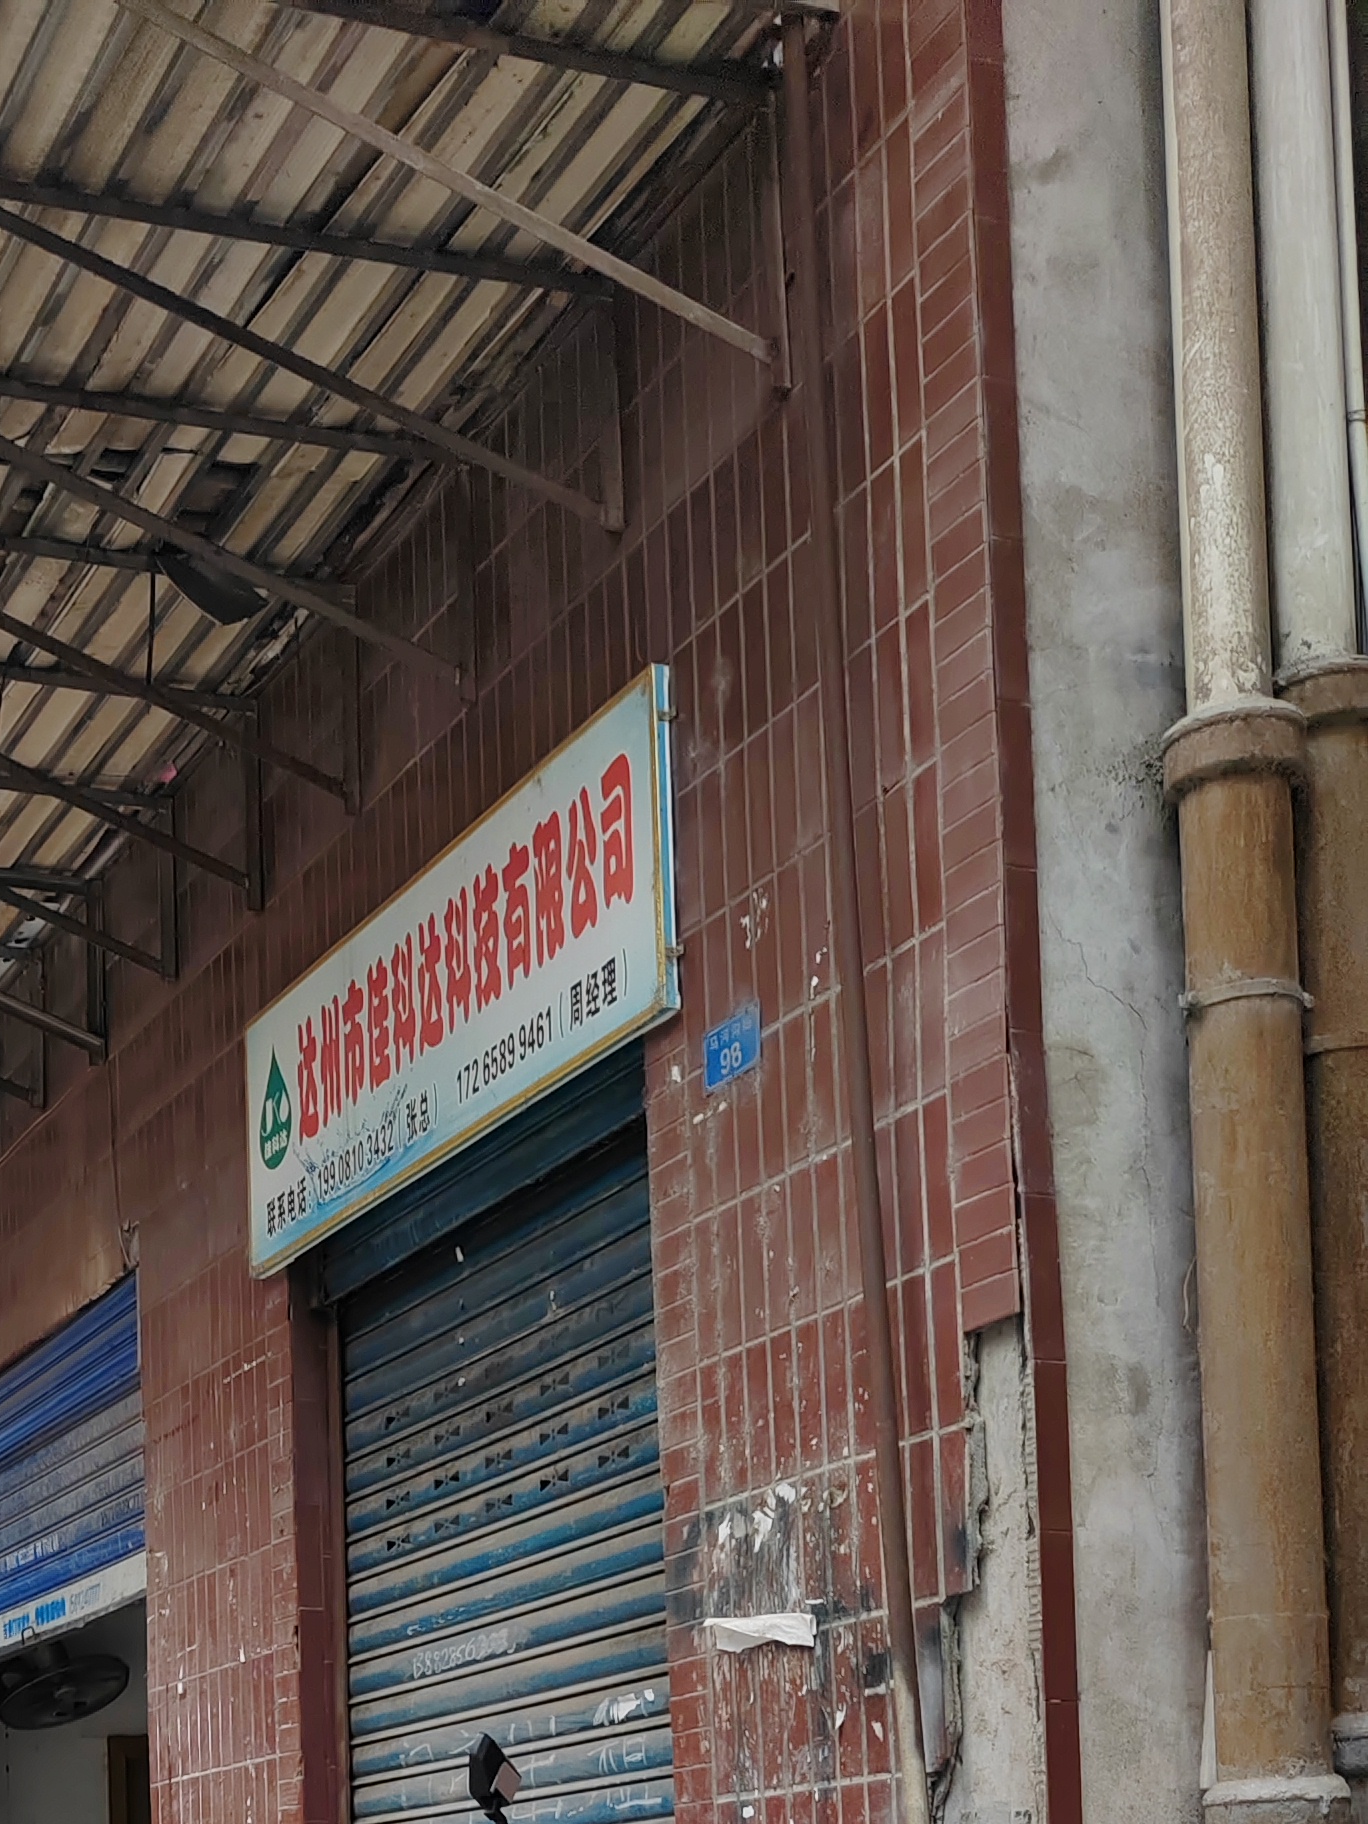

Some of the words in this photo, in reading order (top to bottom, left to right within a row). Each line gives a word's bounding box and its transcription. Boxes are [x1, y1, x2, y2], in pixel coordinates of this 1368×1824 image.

[297, 753, 634, 1147] 达州市佳科达科技有限公司
[720, 1041, 742, 1075] 98
